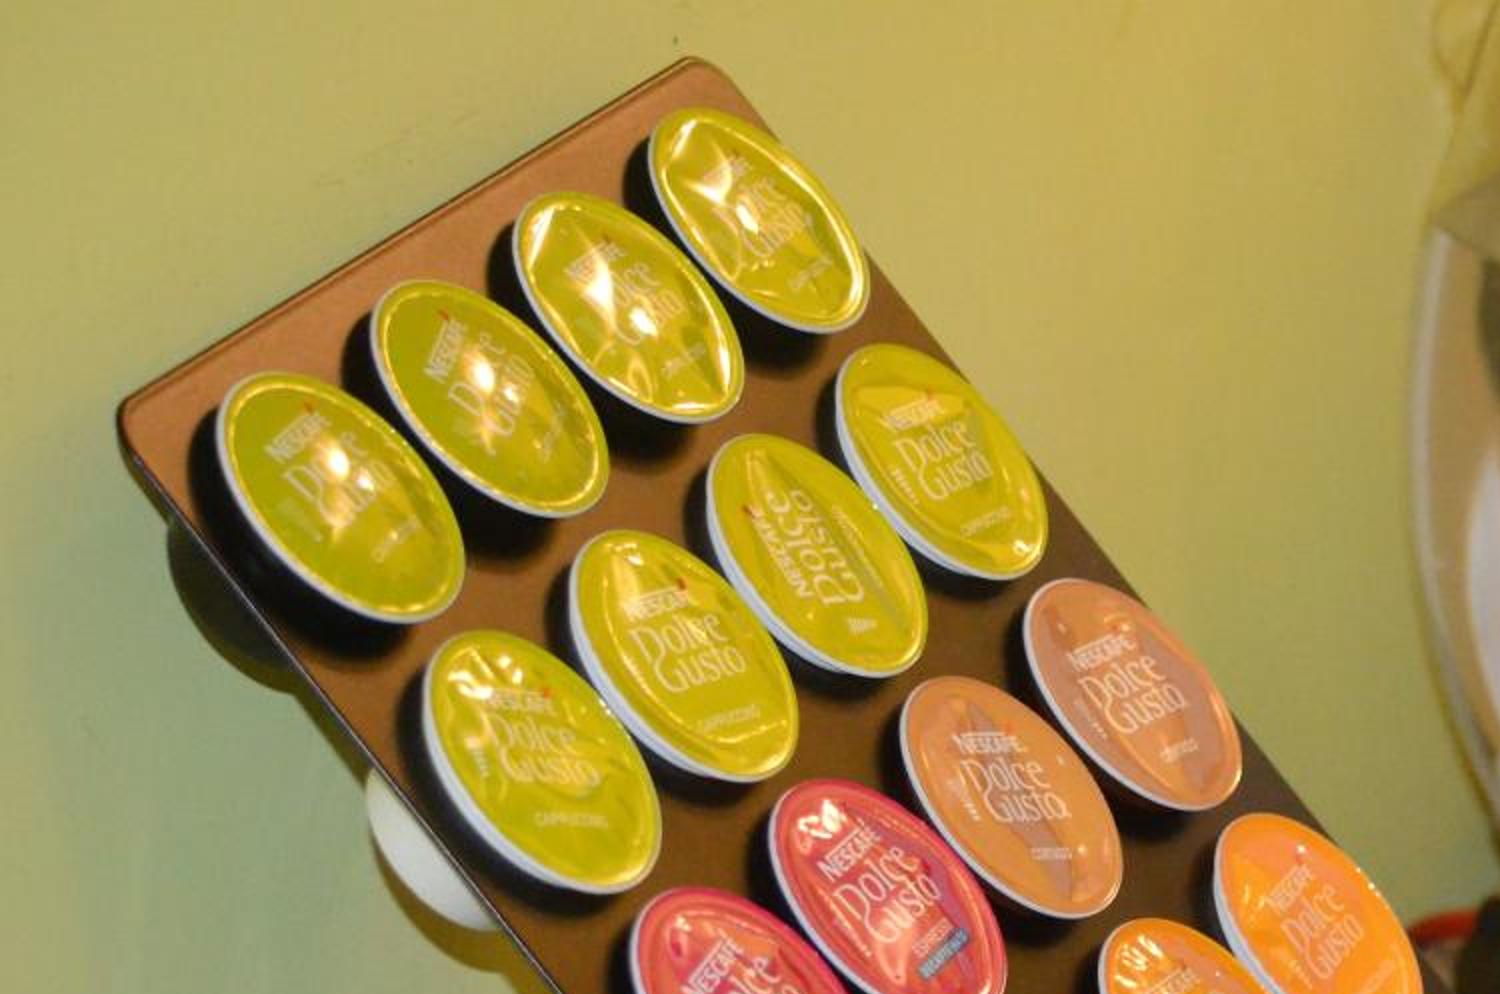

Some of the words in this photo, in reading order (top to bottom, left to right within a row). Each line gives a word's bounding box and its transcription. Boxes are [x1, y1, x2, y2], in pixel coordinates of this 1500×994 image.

[892, 418, 977, 473] Dolce
[916, 450, 993, 501] Gusto
[628, 613, 730, 666] Dolce
[653, 643, 747, 693] Gusto
[1077, 656, 1167, 709] Dolce
[1103, 684, 1189, 734] Gusto
[958, 757, 1053, 792] Dolce
[983, 791, 1073, 823] Gusto
[832, 847, 922, 921] Dolce
[863, 872, 941, 944] Gusto
[1279, 884, 1346, 955] Dolce
[1303, 912, 1365, 981] Gusto
